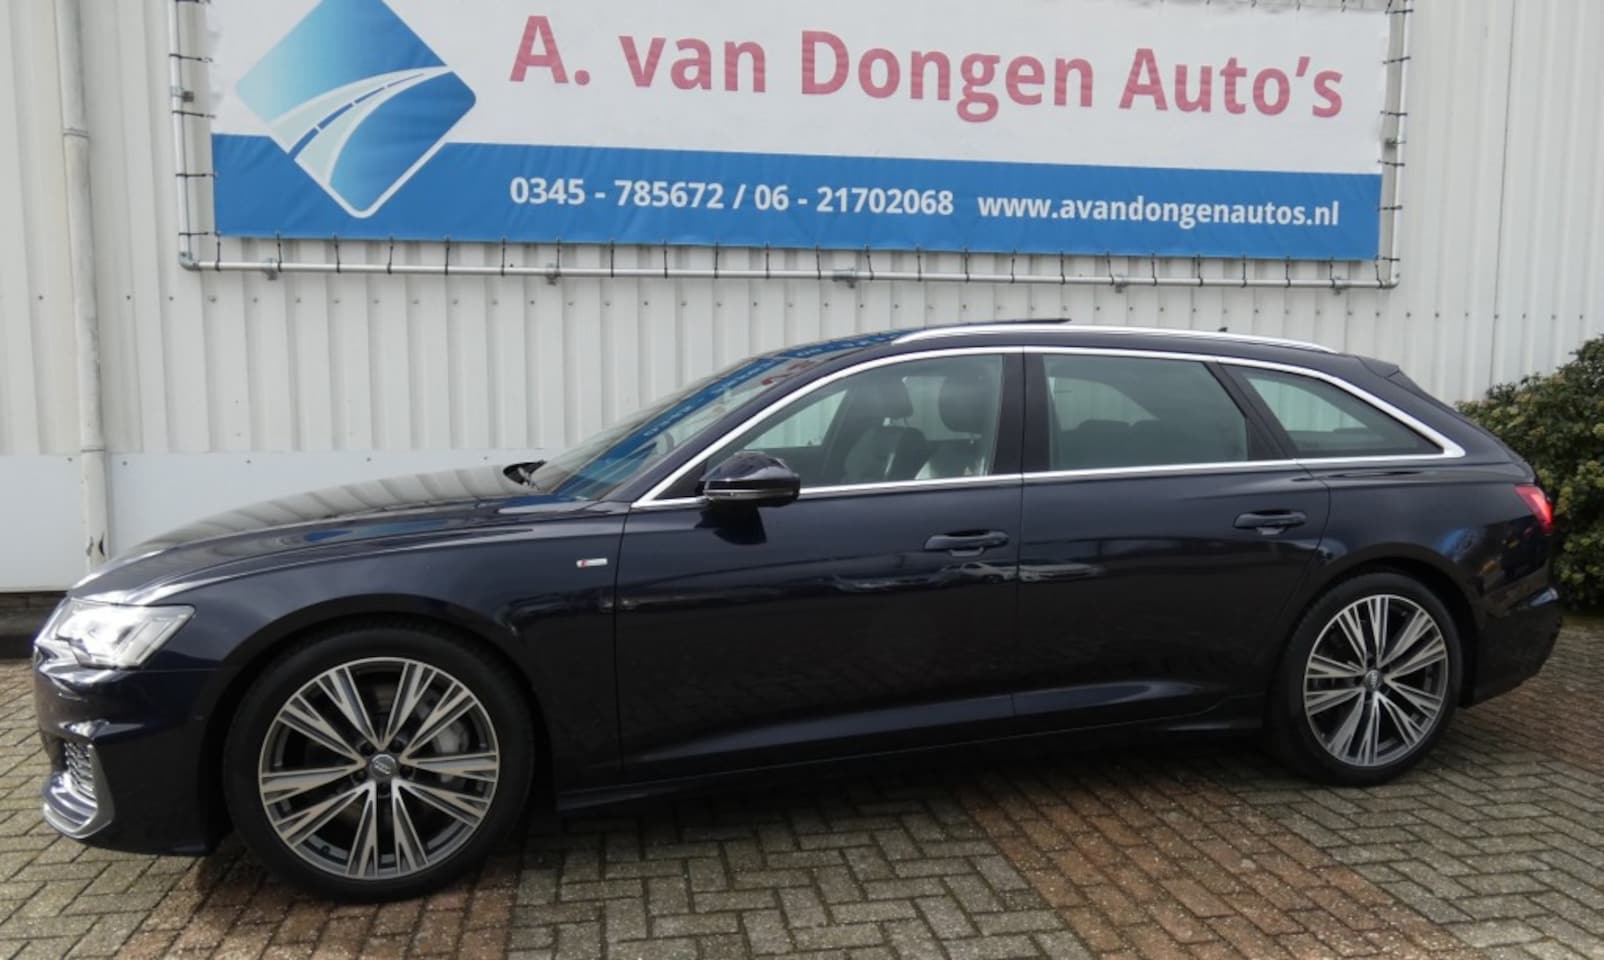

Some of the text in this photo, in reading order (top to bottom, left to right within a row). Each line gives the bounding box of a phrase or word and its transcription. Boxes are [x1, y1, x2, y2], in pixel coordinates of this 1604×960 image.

[511, 15, 1343, 123] A. van Dongen Auto's
[510, 177, 586, 205] 0345
[614, 180, 724, 209] 785672
[733, 184, 746, 210] /
[754, 184, 789, 211] 06
[816, 186, 954, 215] 21702068
[977, 195, 1339, 229] www.avandongenautos.nl
